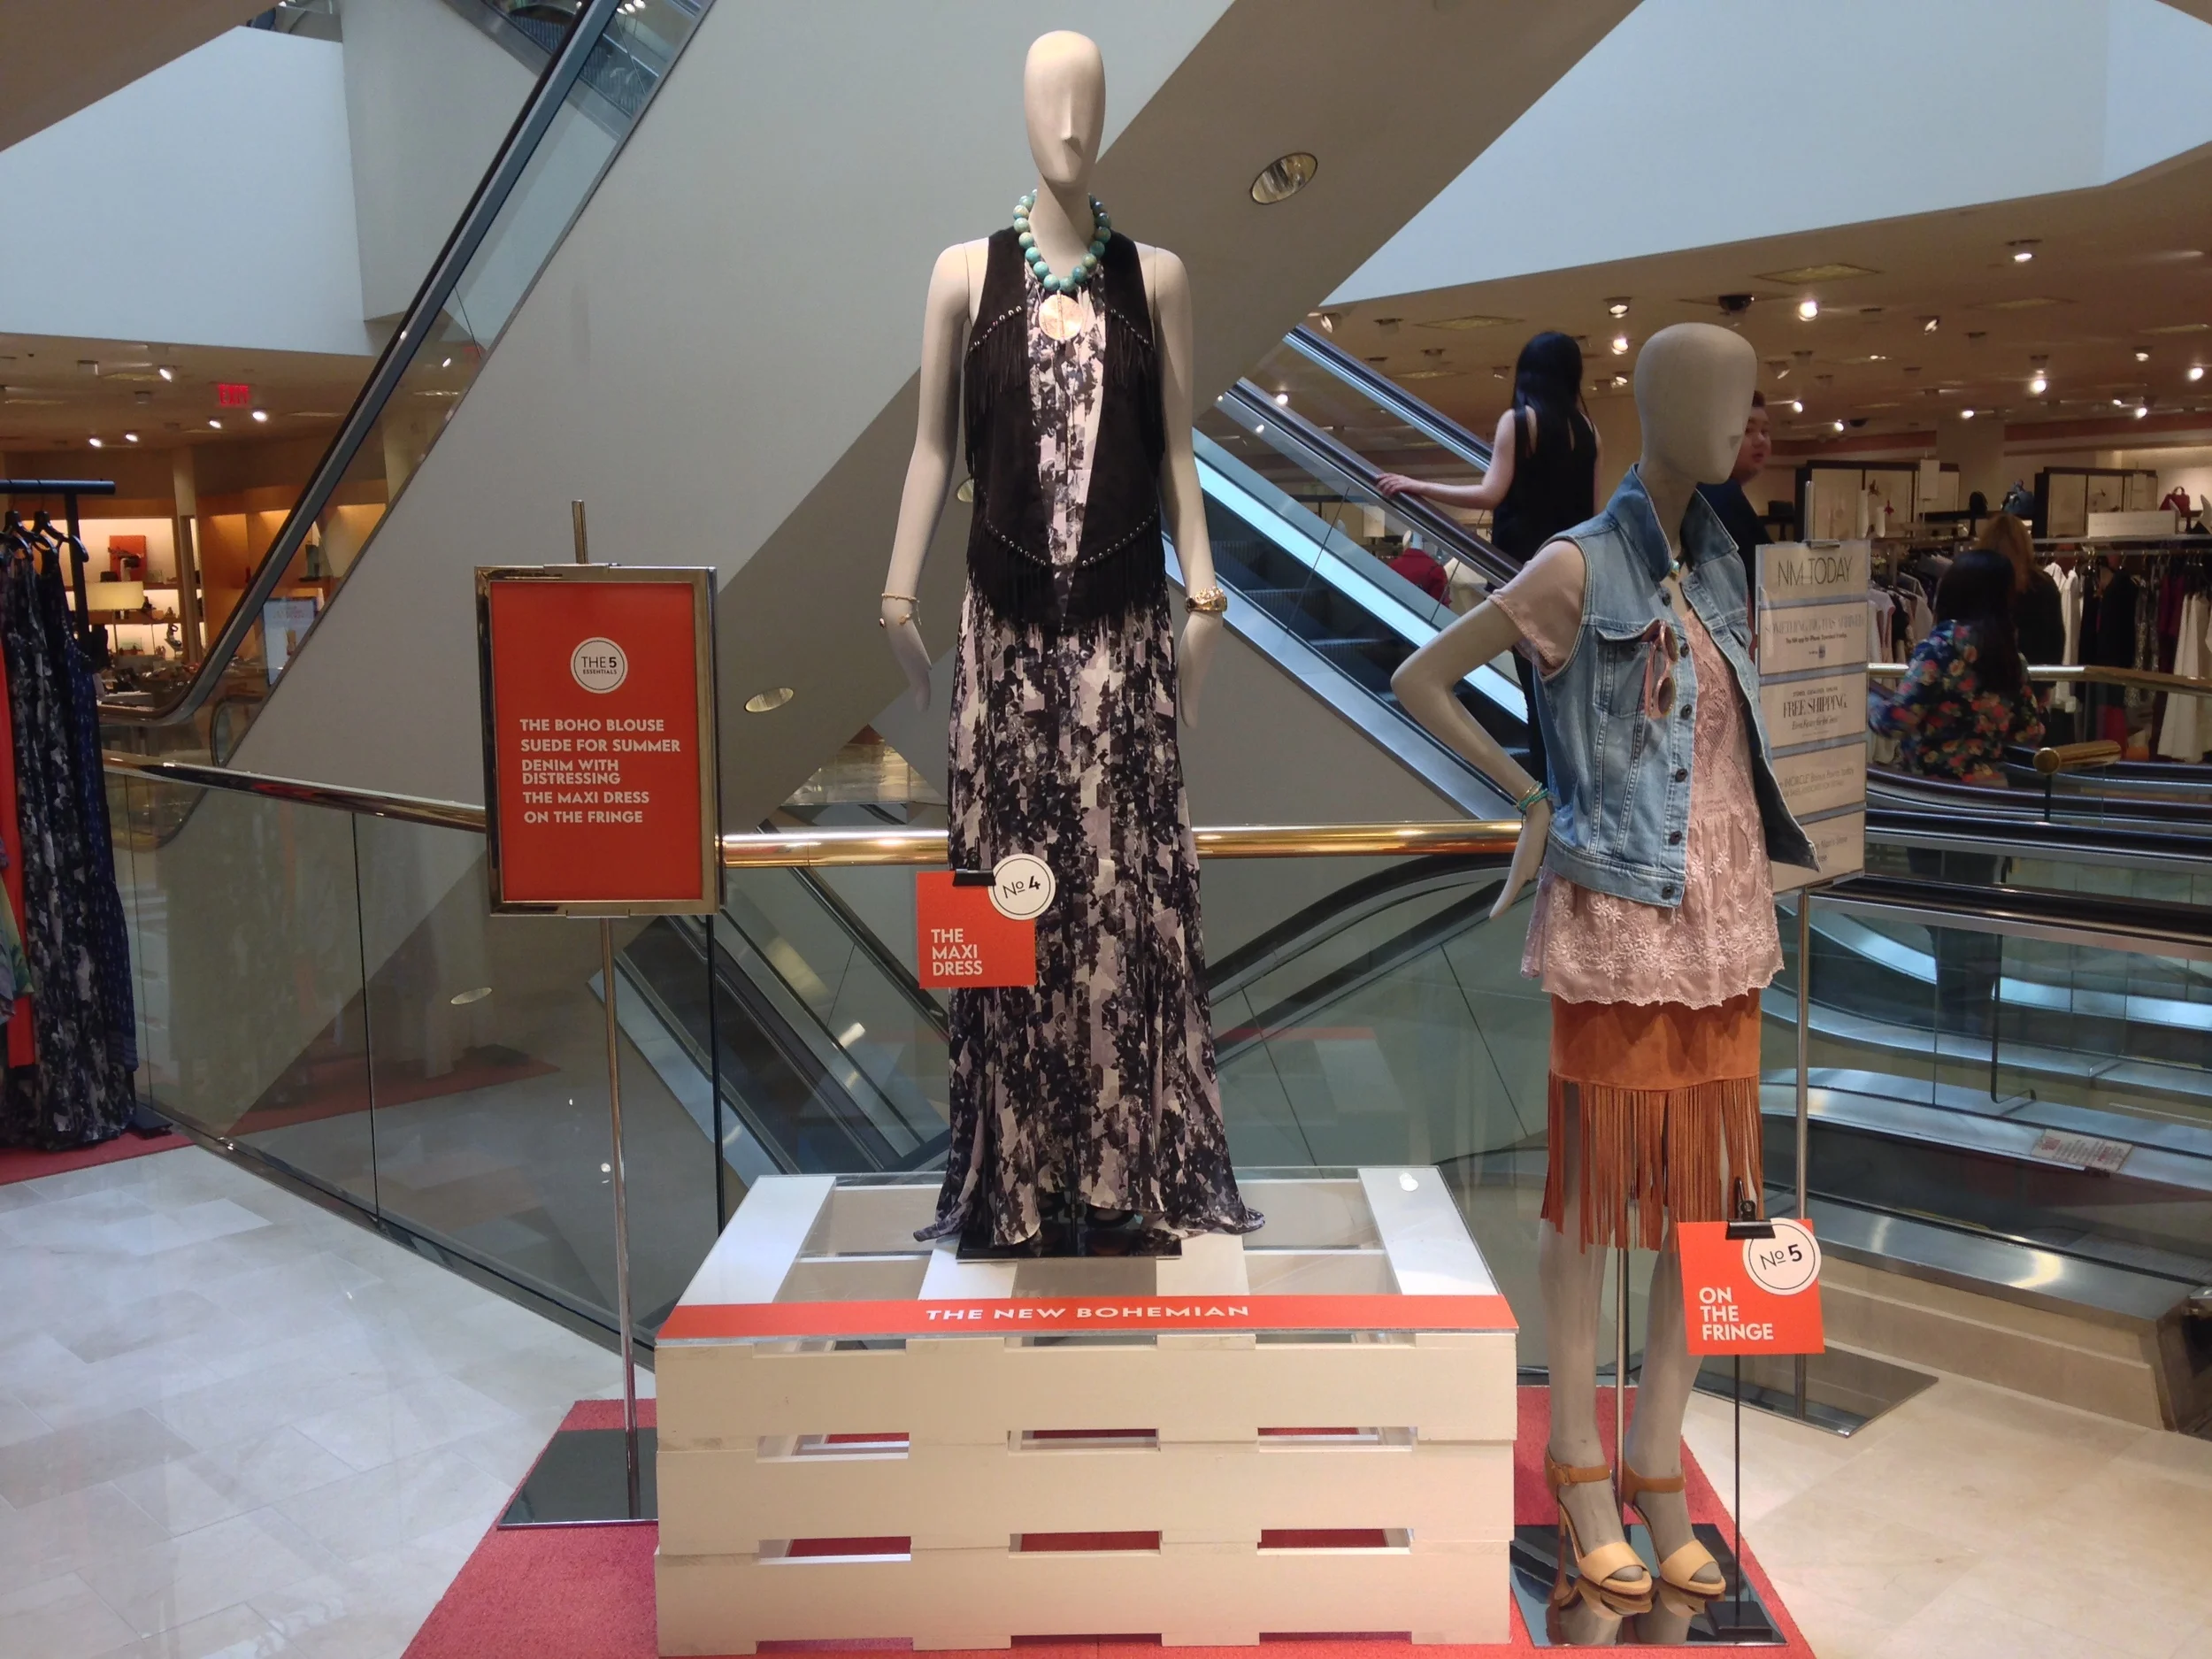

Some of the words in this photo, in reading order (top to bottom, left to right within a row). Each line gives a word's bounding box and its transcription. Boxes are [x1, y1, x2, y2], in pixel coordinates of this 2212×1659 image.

[1778, 560, 1804, 587] NM
[1808, 556, 1853, 585] TODAY
[581, 656, 606, 668] THE
[609, 656, 618, 668] 5
[1783, 698, 1806, 718] FREE
[519, 718, 550, 732] THE
[555, 718, 602, 732] BOHO
[606, 718, 664, 732] BLOUSE
[520, 739, 572, 752] SUEDE
[576, 739, 608, 752] FOR
[612, 739, 680, 752] SUMMER
[521, 759, 573, 772] DENIM
[578, 759, 618, 772] WITH
[522, 772, 621, 785] DISTRESSING
[523, 791, 553, 804] THE
[557, 791, 599, 804] MAXI
[603, 791, 649, 804] DRESS
[524, 810, 549, 824] ON
[553, 810, 583, 824] THE
[588, 810, 643, 824] FRINGE
[1028, 875, 1041, 890] 4
[931, 928, 964, 943] THE
[932, 944, 978, 960] MAXI
[933, 960, 983, 976] DRESS
[1788, 1243, 1802, 1262] 5
[1699, 1286, 1732, 1304] ON
[926, 1310, 984, 1320] THE
[994, 1308, 1066, 1319] NEW
[1077, 1305, 1249, 1317] BOHEMIAN
[1700, 1305, 1740, 1322] THE
[1701, 1323, 1774, 1340] FRINGE
